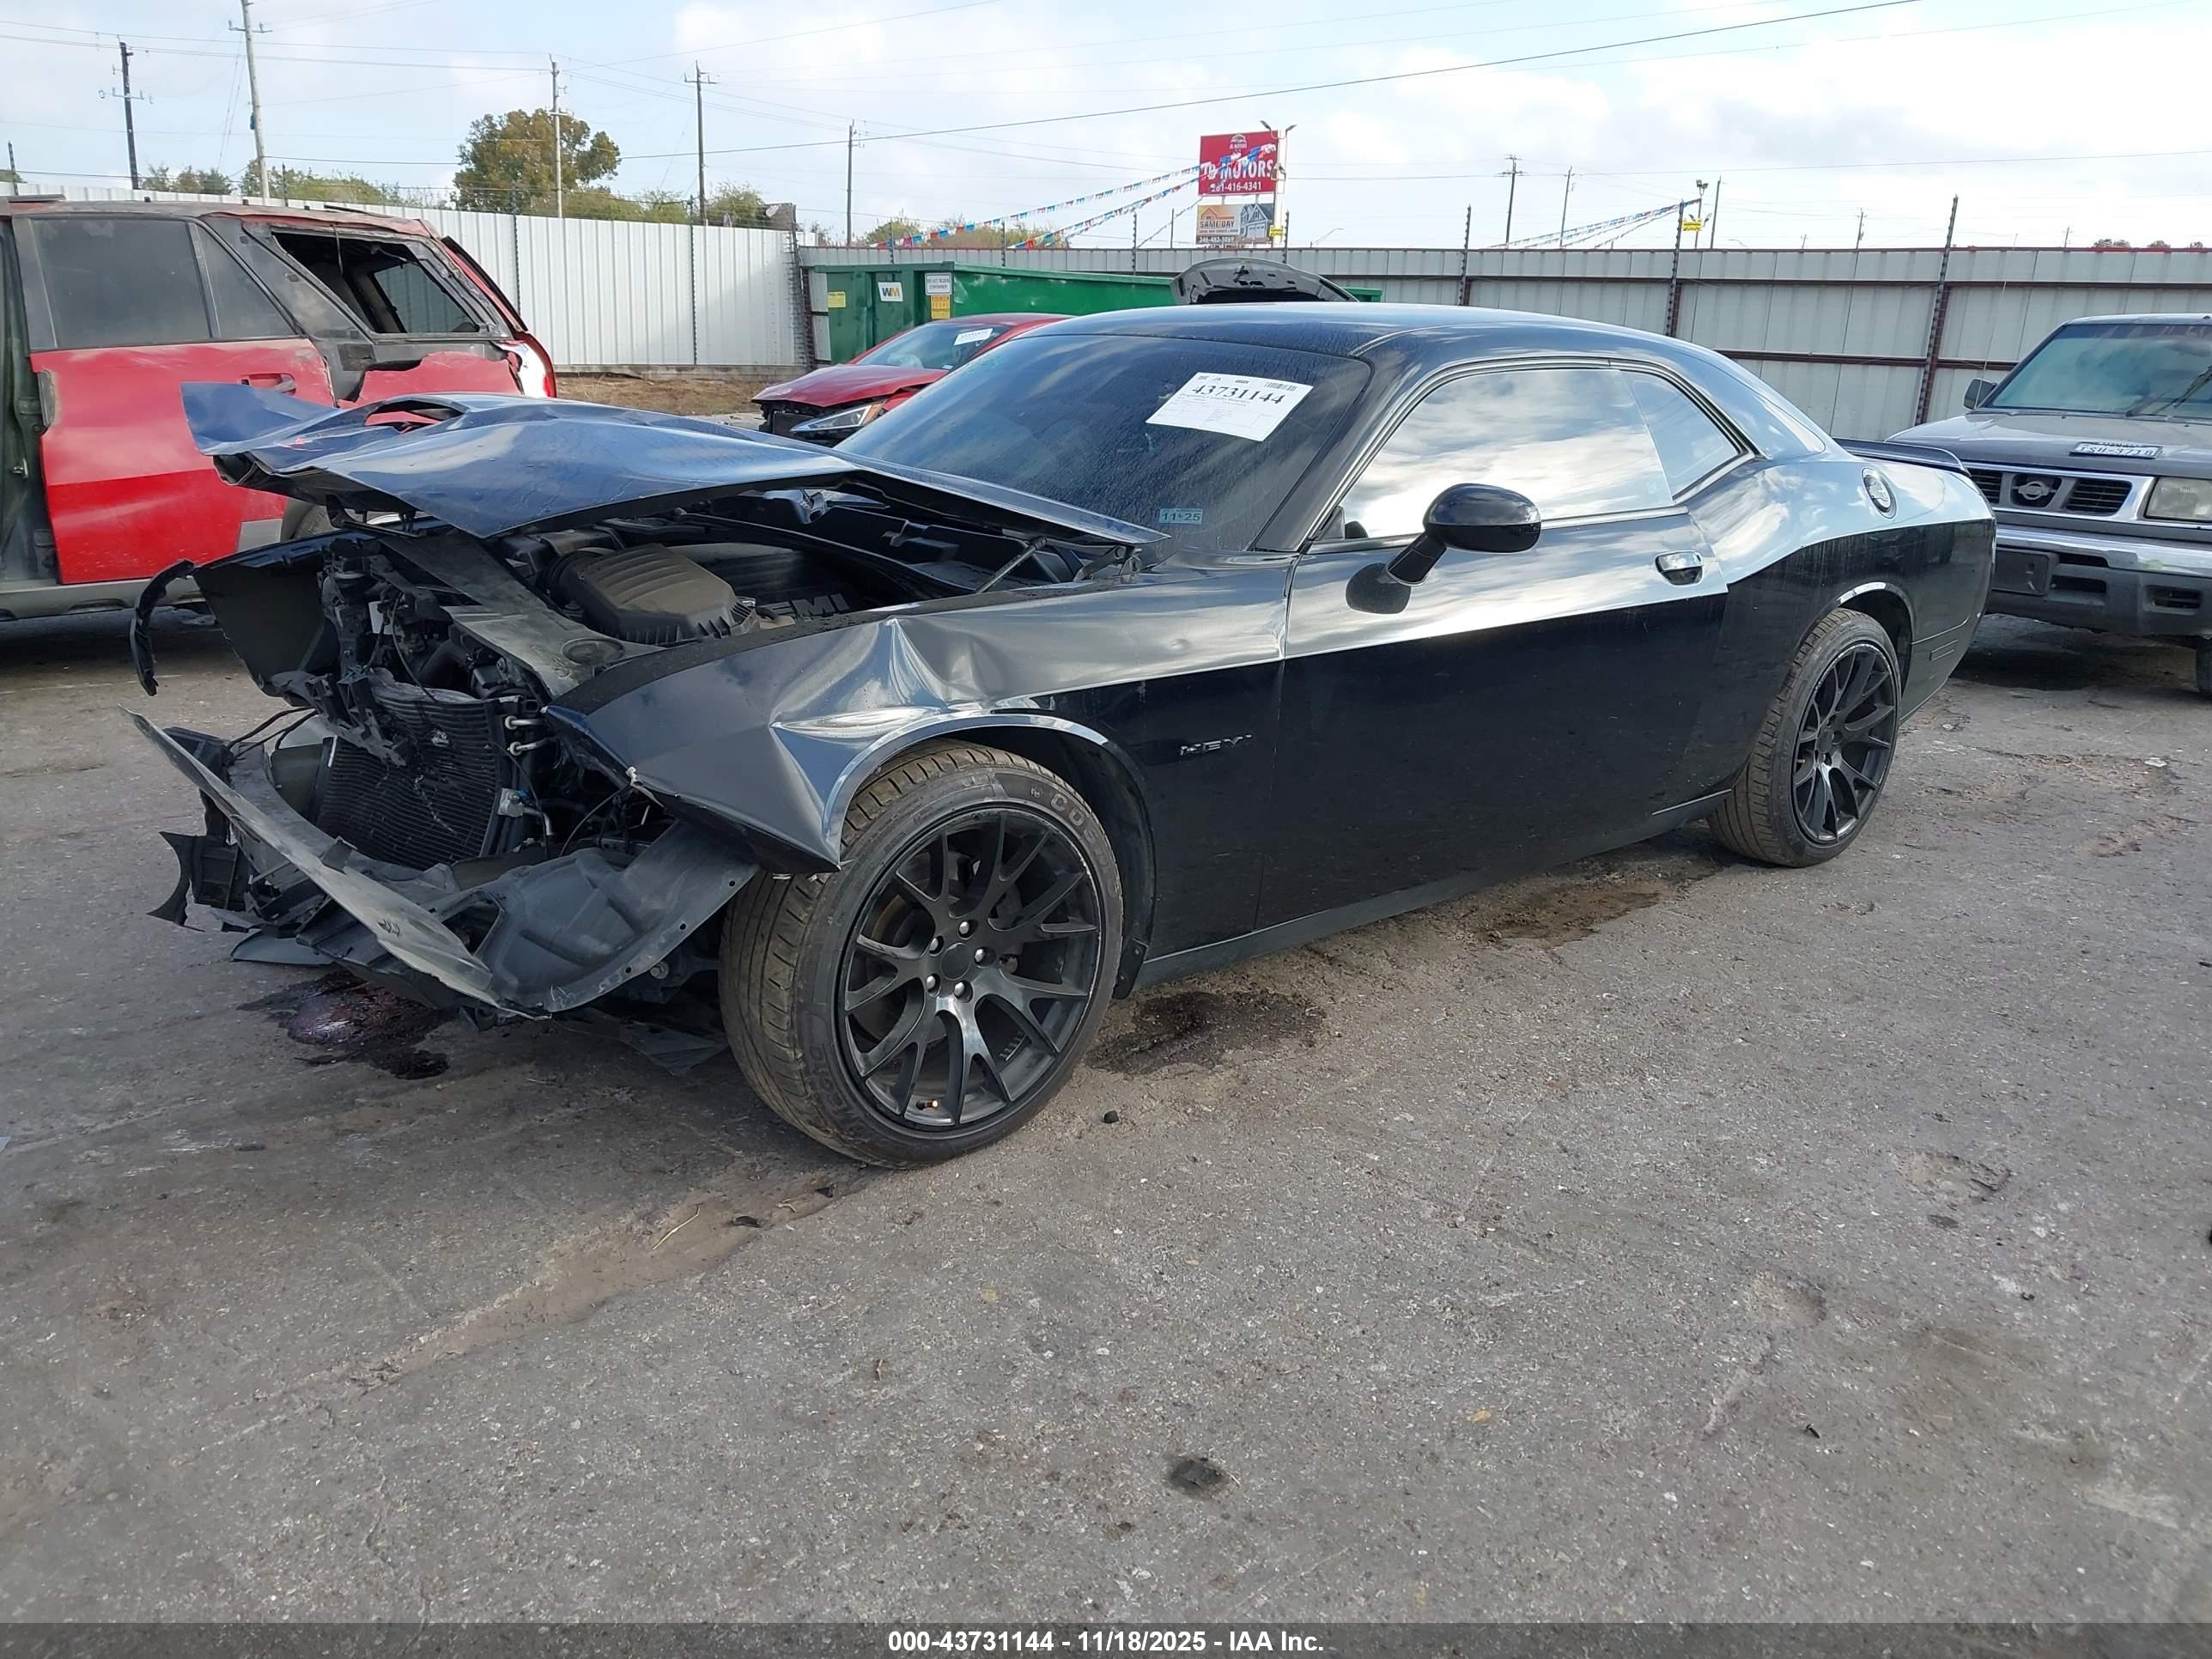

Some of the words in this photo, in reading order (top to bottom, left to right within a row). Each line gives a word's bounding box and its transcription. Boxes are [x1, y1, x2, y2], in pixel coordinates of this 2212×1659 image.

[881, 287, 900, 297] WM
[1192, 384, 1285, 404] 43731144
[1184, 513, 1200, 521] 25
[757, 593, 850, 617] EMI
